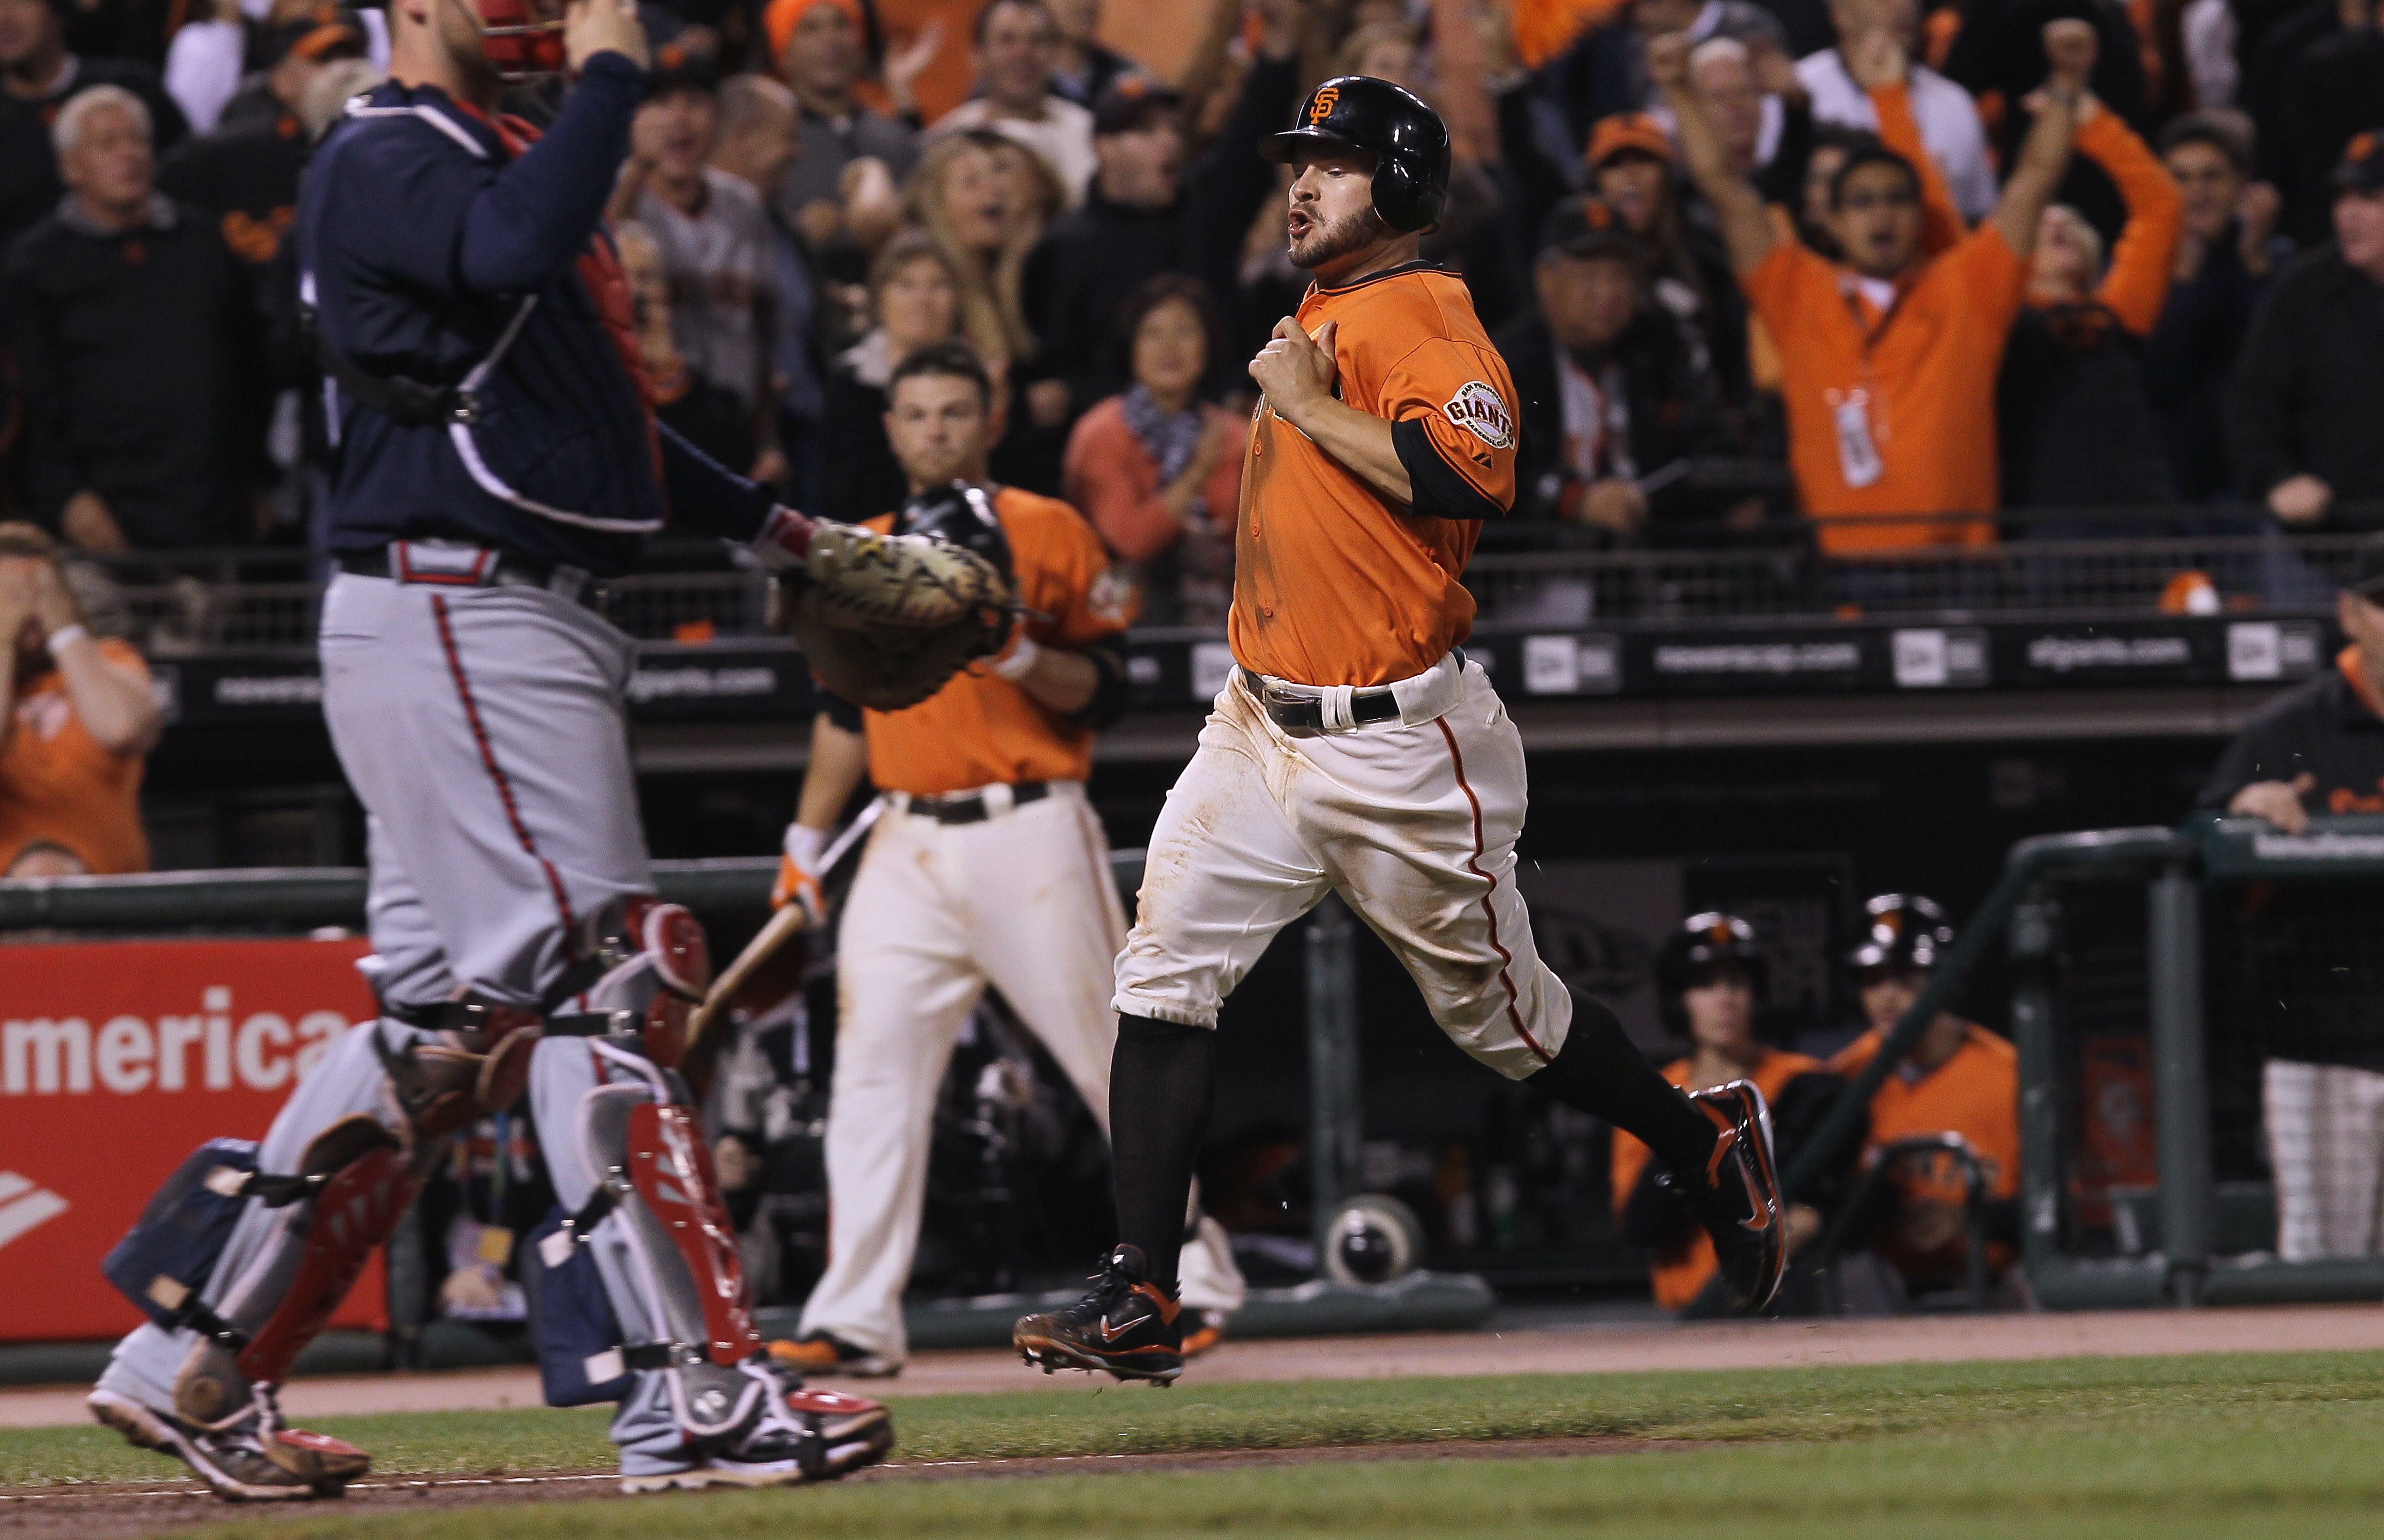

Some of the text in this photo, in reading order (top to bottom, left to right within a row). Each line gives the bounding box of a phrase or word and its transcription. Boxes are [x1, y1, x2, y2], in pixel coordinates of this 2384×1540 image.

[1310, 88, 1339, 124] SF
[1461, 384, 1473, 397] SAN
[1447, 399, 1514, 445] GIANTS
[1466, 420, 1497, 446] BASEBALL
